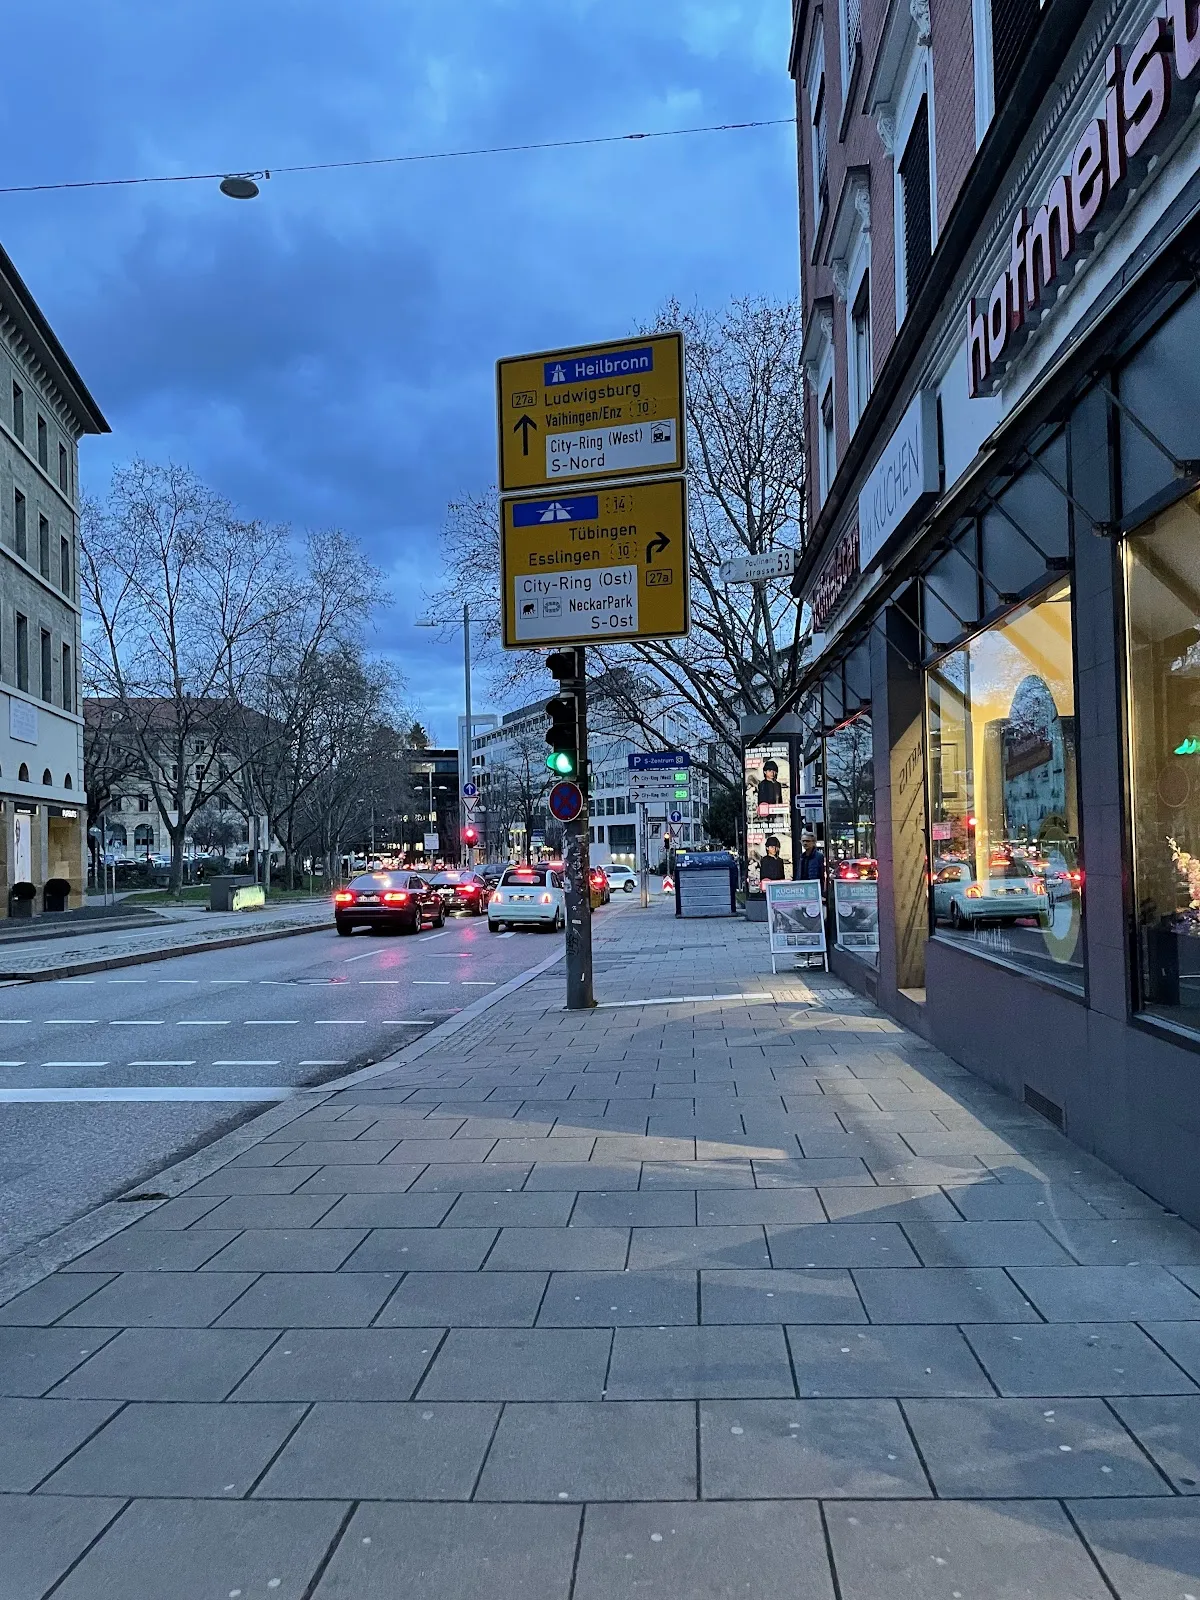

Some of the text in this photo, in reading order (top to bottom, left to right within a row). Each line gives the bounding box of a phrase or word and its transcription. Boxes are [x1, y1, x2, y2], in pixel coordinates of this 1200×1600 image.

[575, 354, 649, 378] Heilbronn
[515, 393, 534, 405] 27a
[544, 382, 641, 407] Ludwigsburg
[637, 402, 649, 413] 10
[546, 406, 622, 428] Vaihingen/Enz
[551, 428, 643, 453] City-Ring (West)
[552, 453, 605, 473] S-Nord
[613, 499, 625, 510] 14
[569, 525, 637, 542] Tübingen
[529, 549, 600, 567] Esslingen
[618, 545, 629, 556] 10
[777, 552, 790, 572] 53
[523, 570, 633, 595] City-Ring (Ost)
[649, 572, 669, 584] 27a
[569, 594, 633, 613] NeckarPark
[591, 614, 634, 630] S-Ost
[633, 756, 641, 767] P
